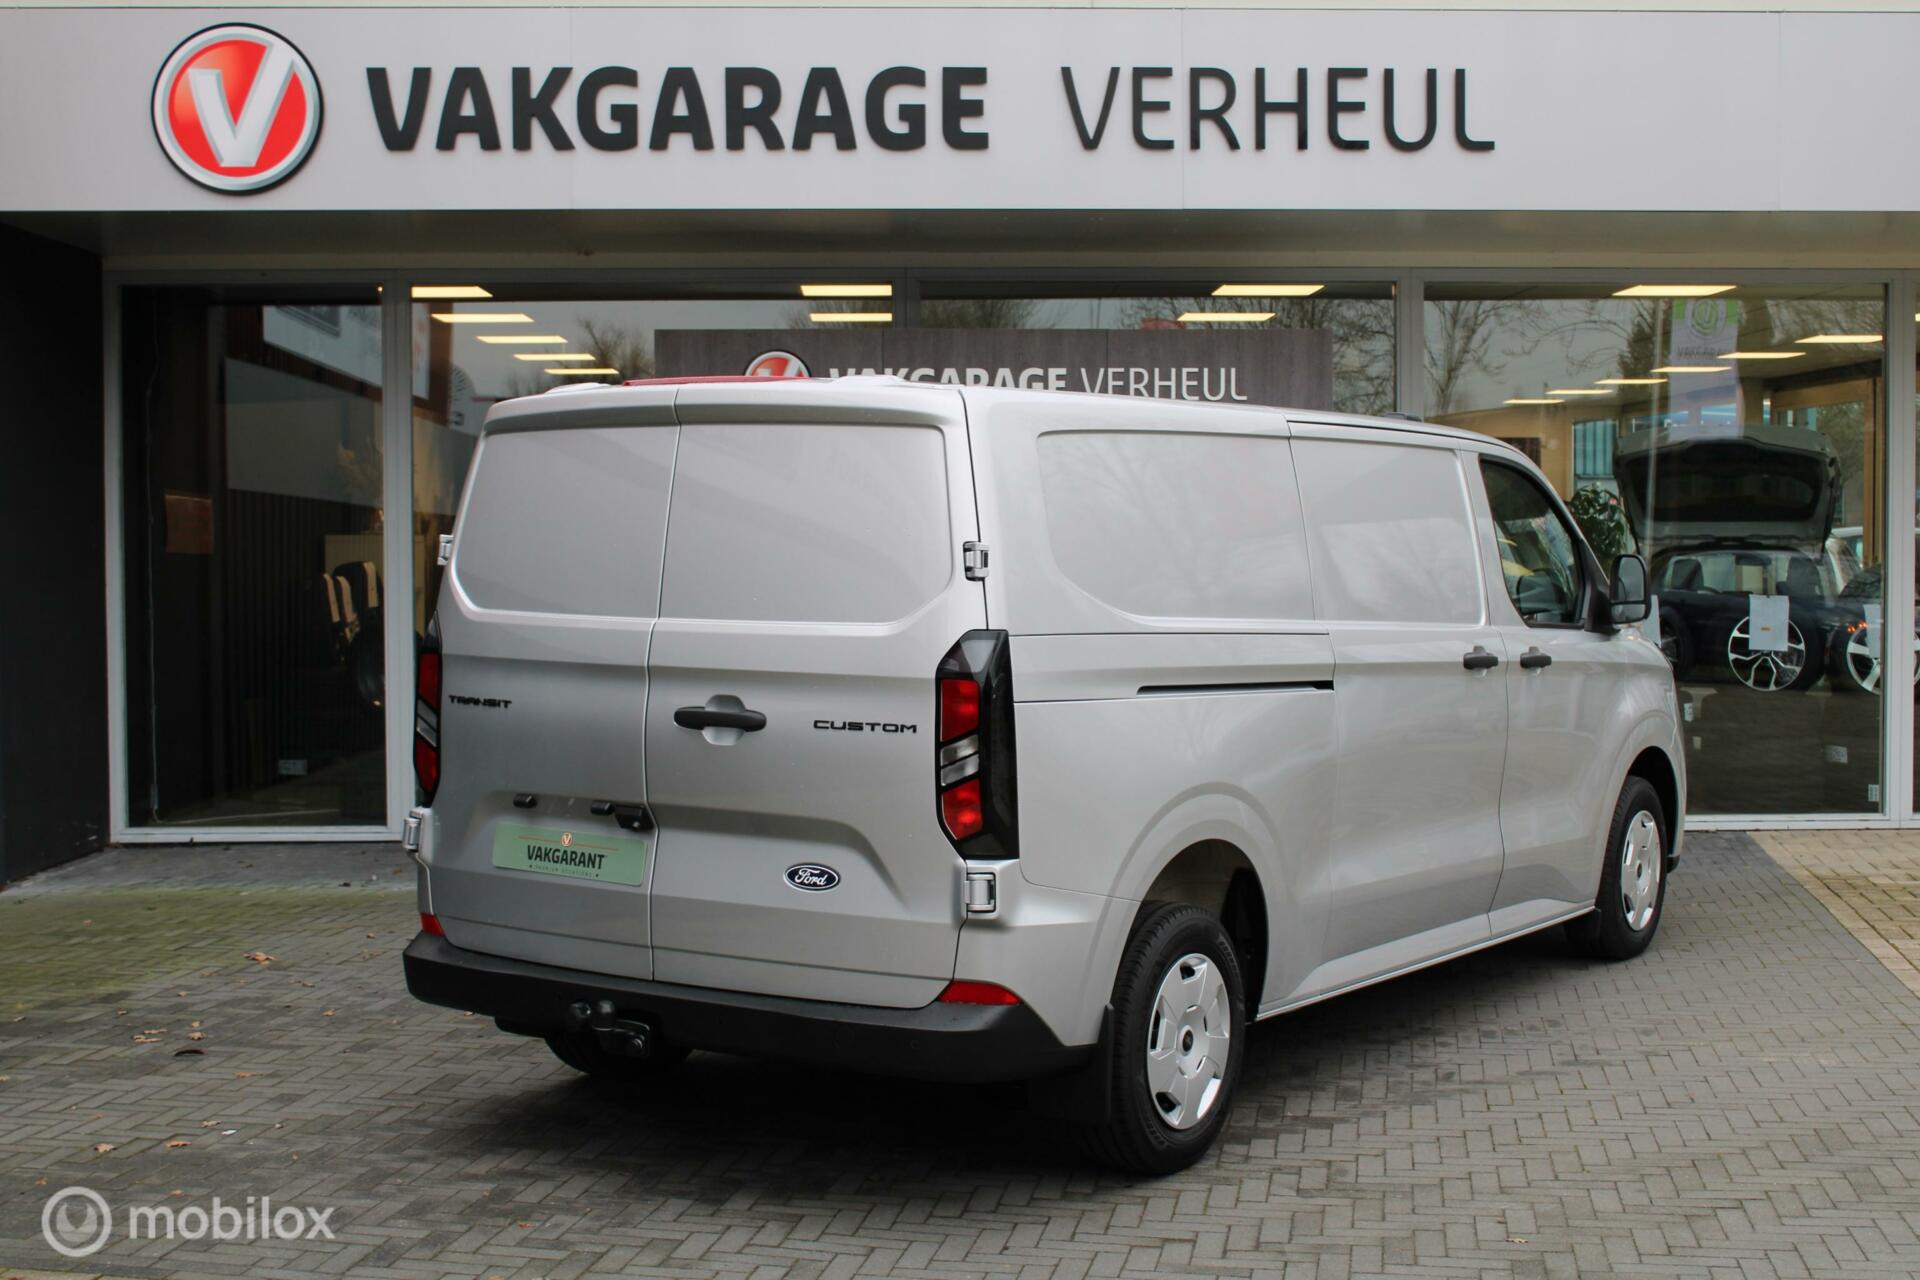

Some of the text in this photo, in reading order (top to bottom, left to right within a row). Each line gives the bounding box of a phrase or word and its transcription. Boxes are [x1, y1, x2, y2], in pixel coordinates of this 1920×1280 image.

[365, 65, 1496, 153] VAKGARAGE VERHEUL
[1080, 367, 1249, 401] VERHEUL
[448, 694, 512, 709] TRANSIT
[813, 719, 918, 734] CUSTOM
[527, 844, 605, 870] VAKGARANT
[795, 867, 828, 887] Ford
